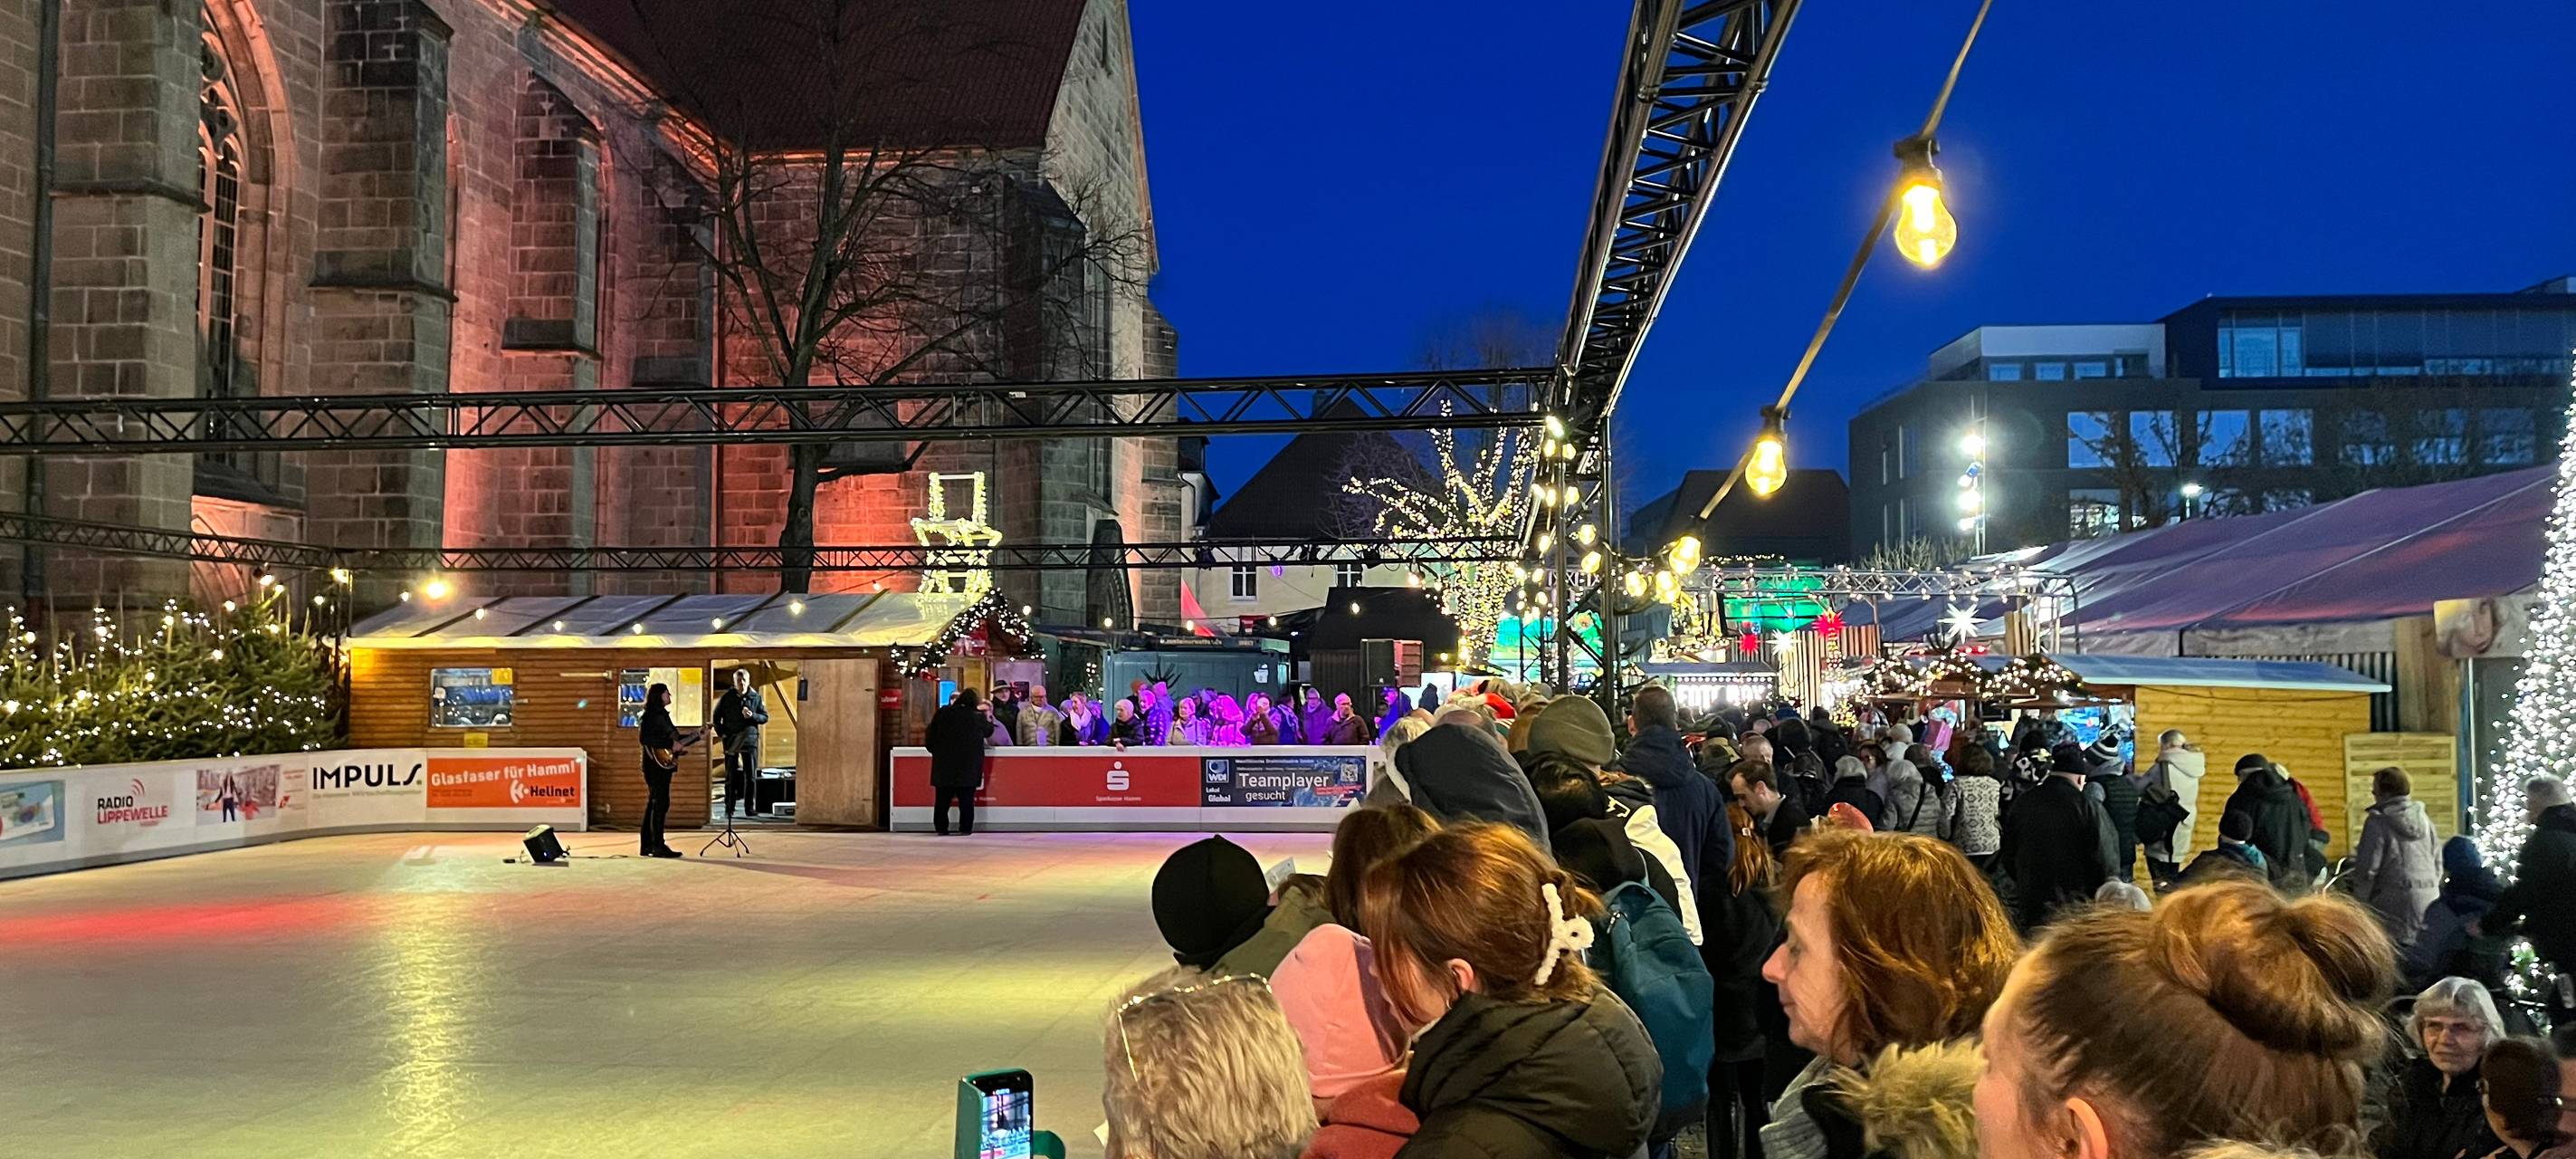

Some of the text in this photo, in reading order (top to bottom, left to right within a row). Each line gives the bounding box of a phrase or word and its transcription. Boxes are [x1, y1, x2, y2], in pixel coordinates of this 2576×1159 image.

[431, 761, 575, 787] Glasfaser für Hamm!
[1208, 773, 1226, 781] WDI
[1239, 772, 1329, 790] Teamplayer
[530, 786, 575, 797] Helinet
[1208, 794, 1231, 802] Global
[1245, 790, 1285, 802] gesucht
[97, 796, 133, 810] RADIO
[97, 805, 168, 824] LIPPEWELLE
